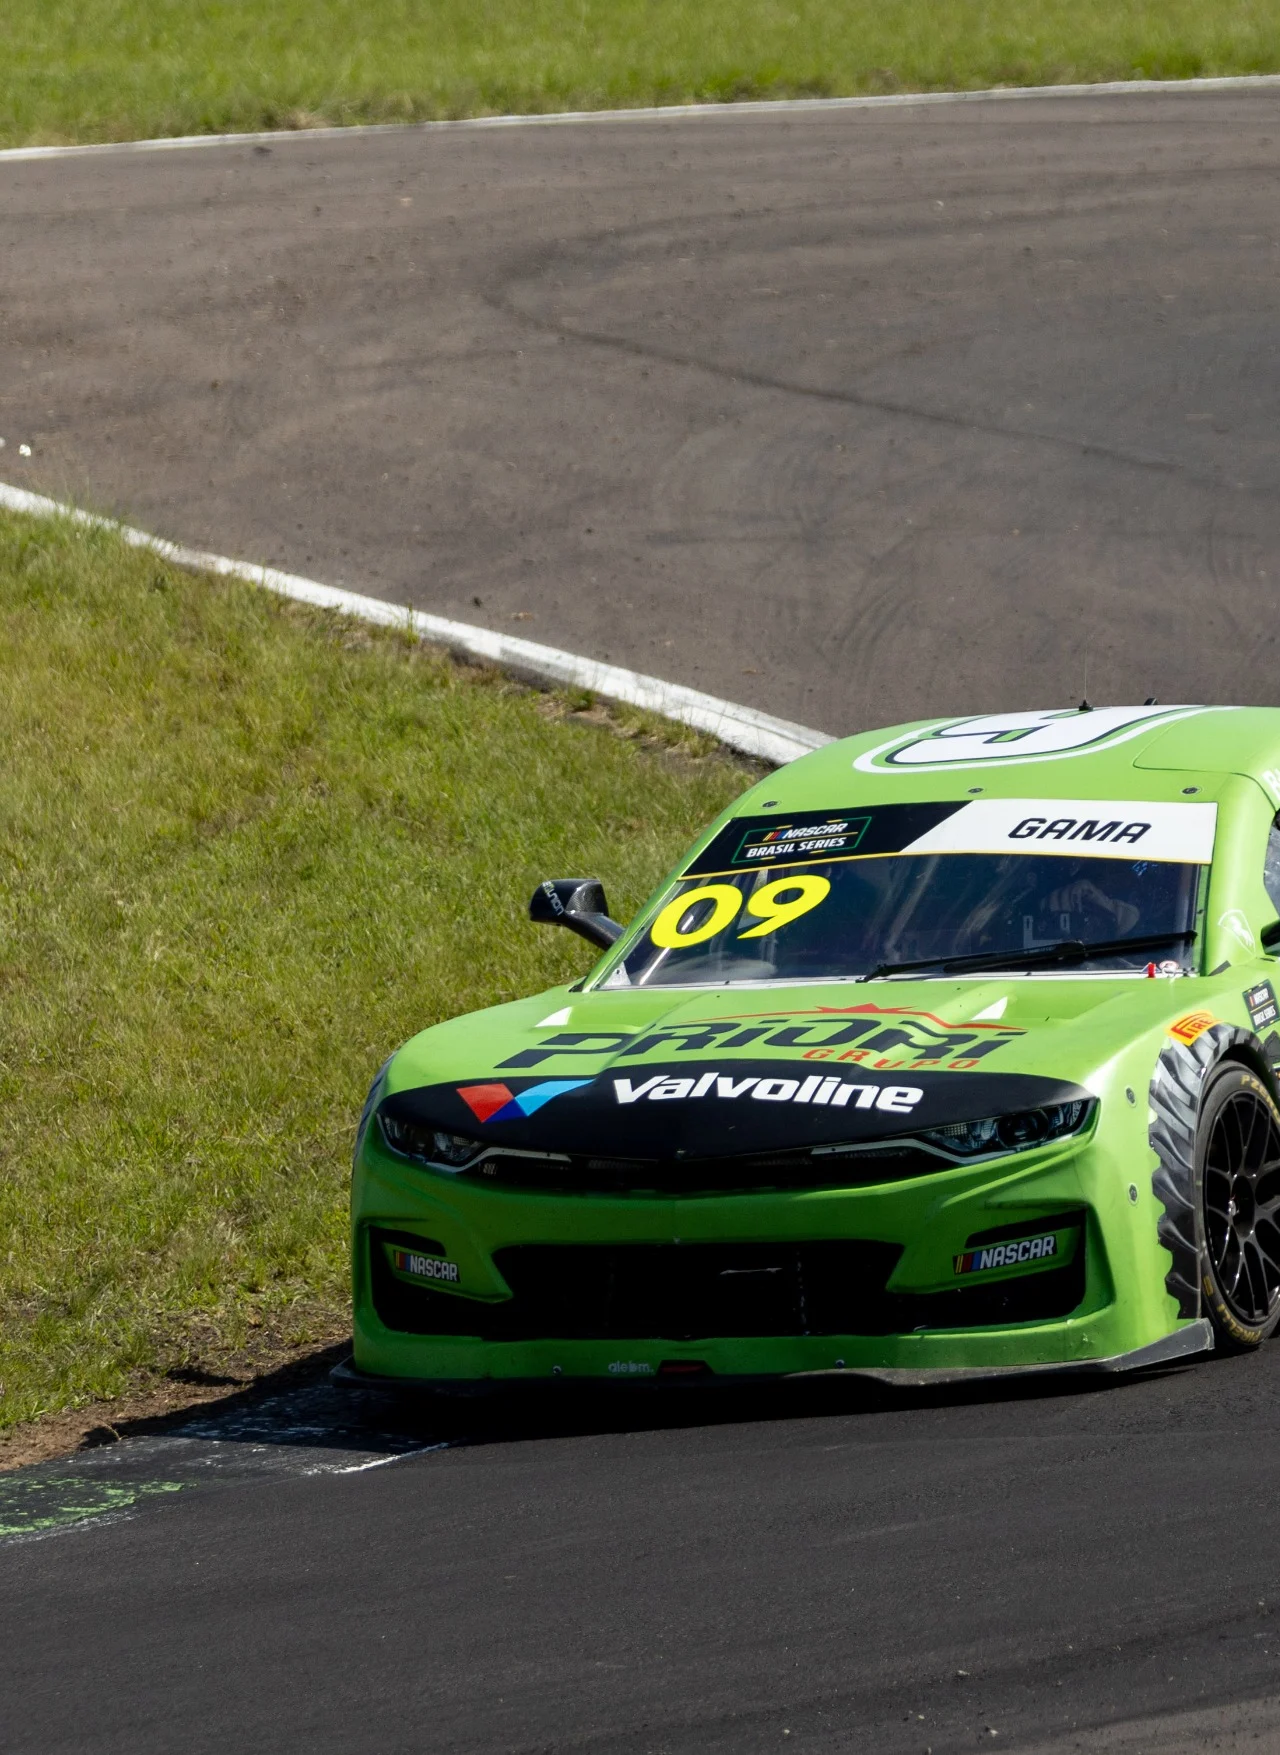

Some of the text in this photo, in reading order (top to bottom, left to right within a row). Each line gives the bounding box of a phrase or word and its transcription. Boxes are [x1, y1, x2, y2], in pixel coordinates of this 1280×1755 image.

[782, 823, 848, 839] NASCAR
[1008, 817, 1152, 843] GAMA
[746, 837, 848, 858] BRASIL SERIES
[650, 874, 832, 948] 09
[801, 1047, 981, 1071] GRUPO
[612, 1071, 924, 1113] Valvoline
[980, 1235, 1055, 1270] NASCAR
[410, 1254, 459, 1281] NASCAR
